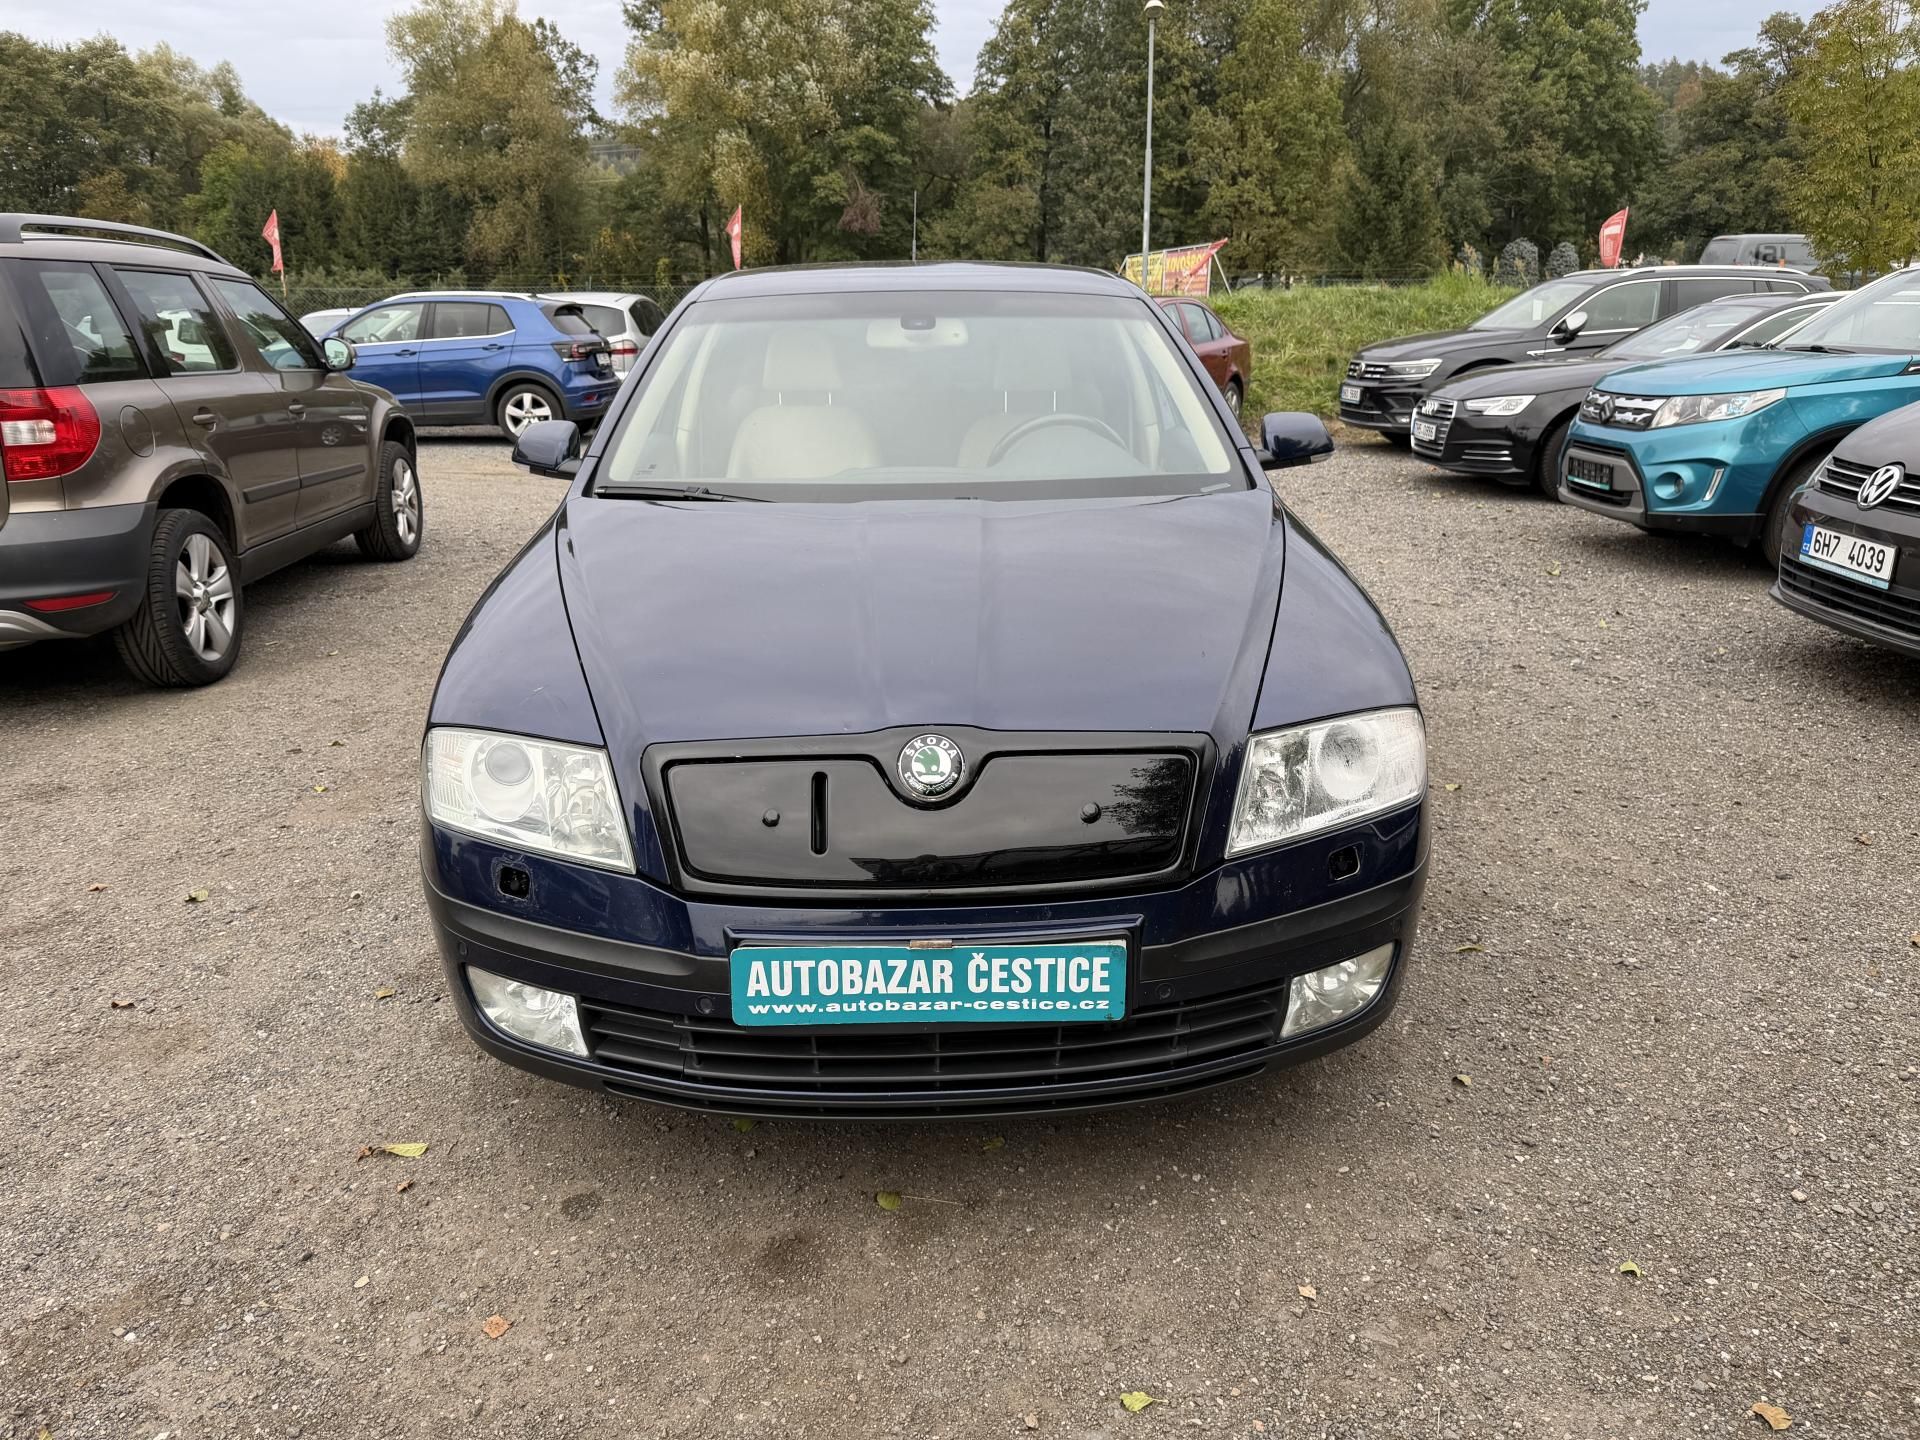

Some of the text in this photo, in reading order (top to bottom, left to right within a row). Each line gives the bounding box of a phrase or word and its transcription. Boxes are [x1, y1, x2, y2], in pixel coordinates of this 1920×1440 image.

[1813, 531, 1841, 558] 6H7
[1847, 541, 1886, 573] 4039
[747, 952, 1110, 997] AUTOBAZAR ČESTICE
[748, 998, 1110, 1014] www.autobazar-cestice.cz
